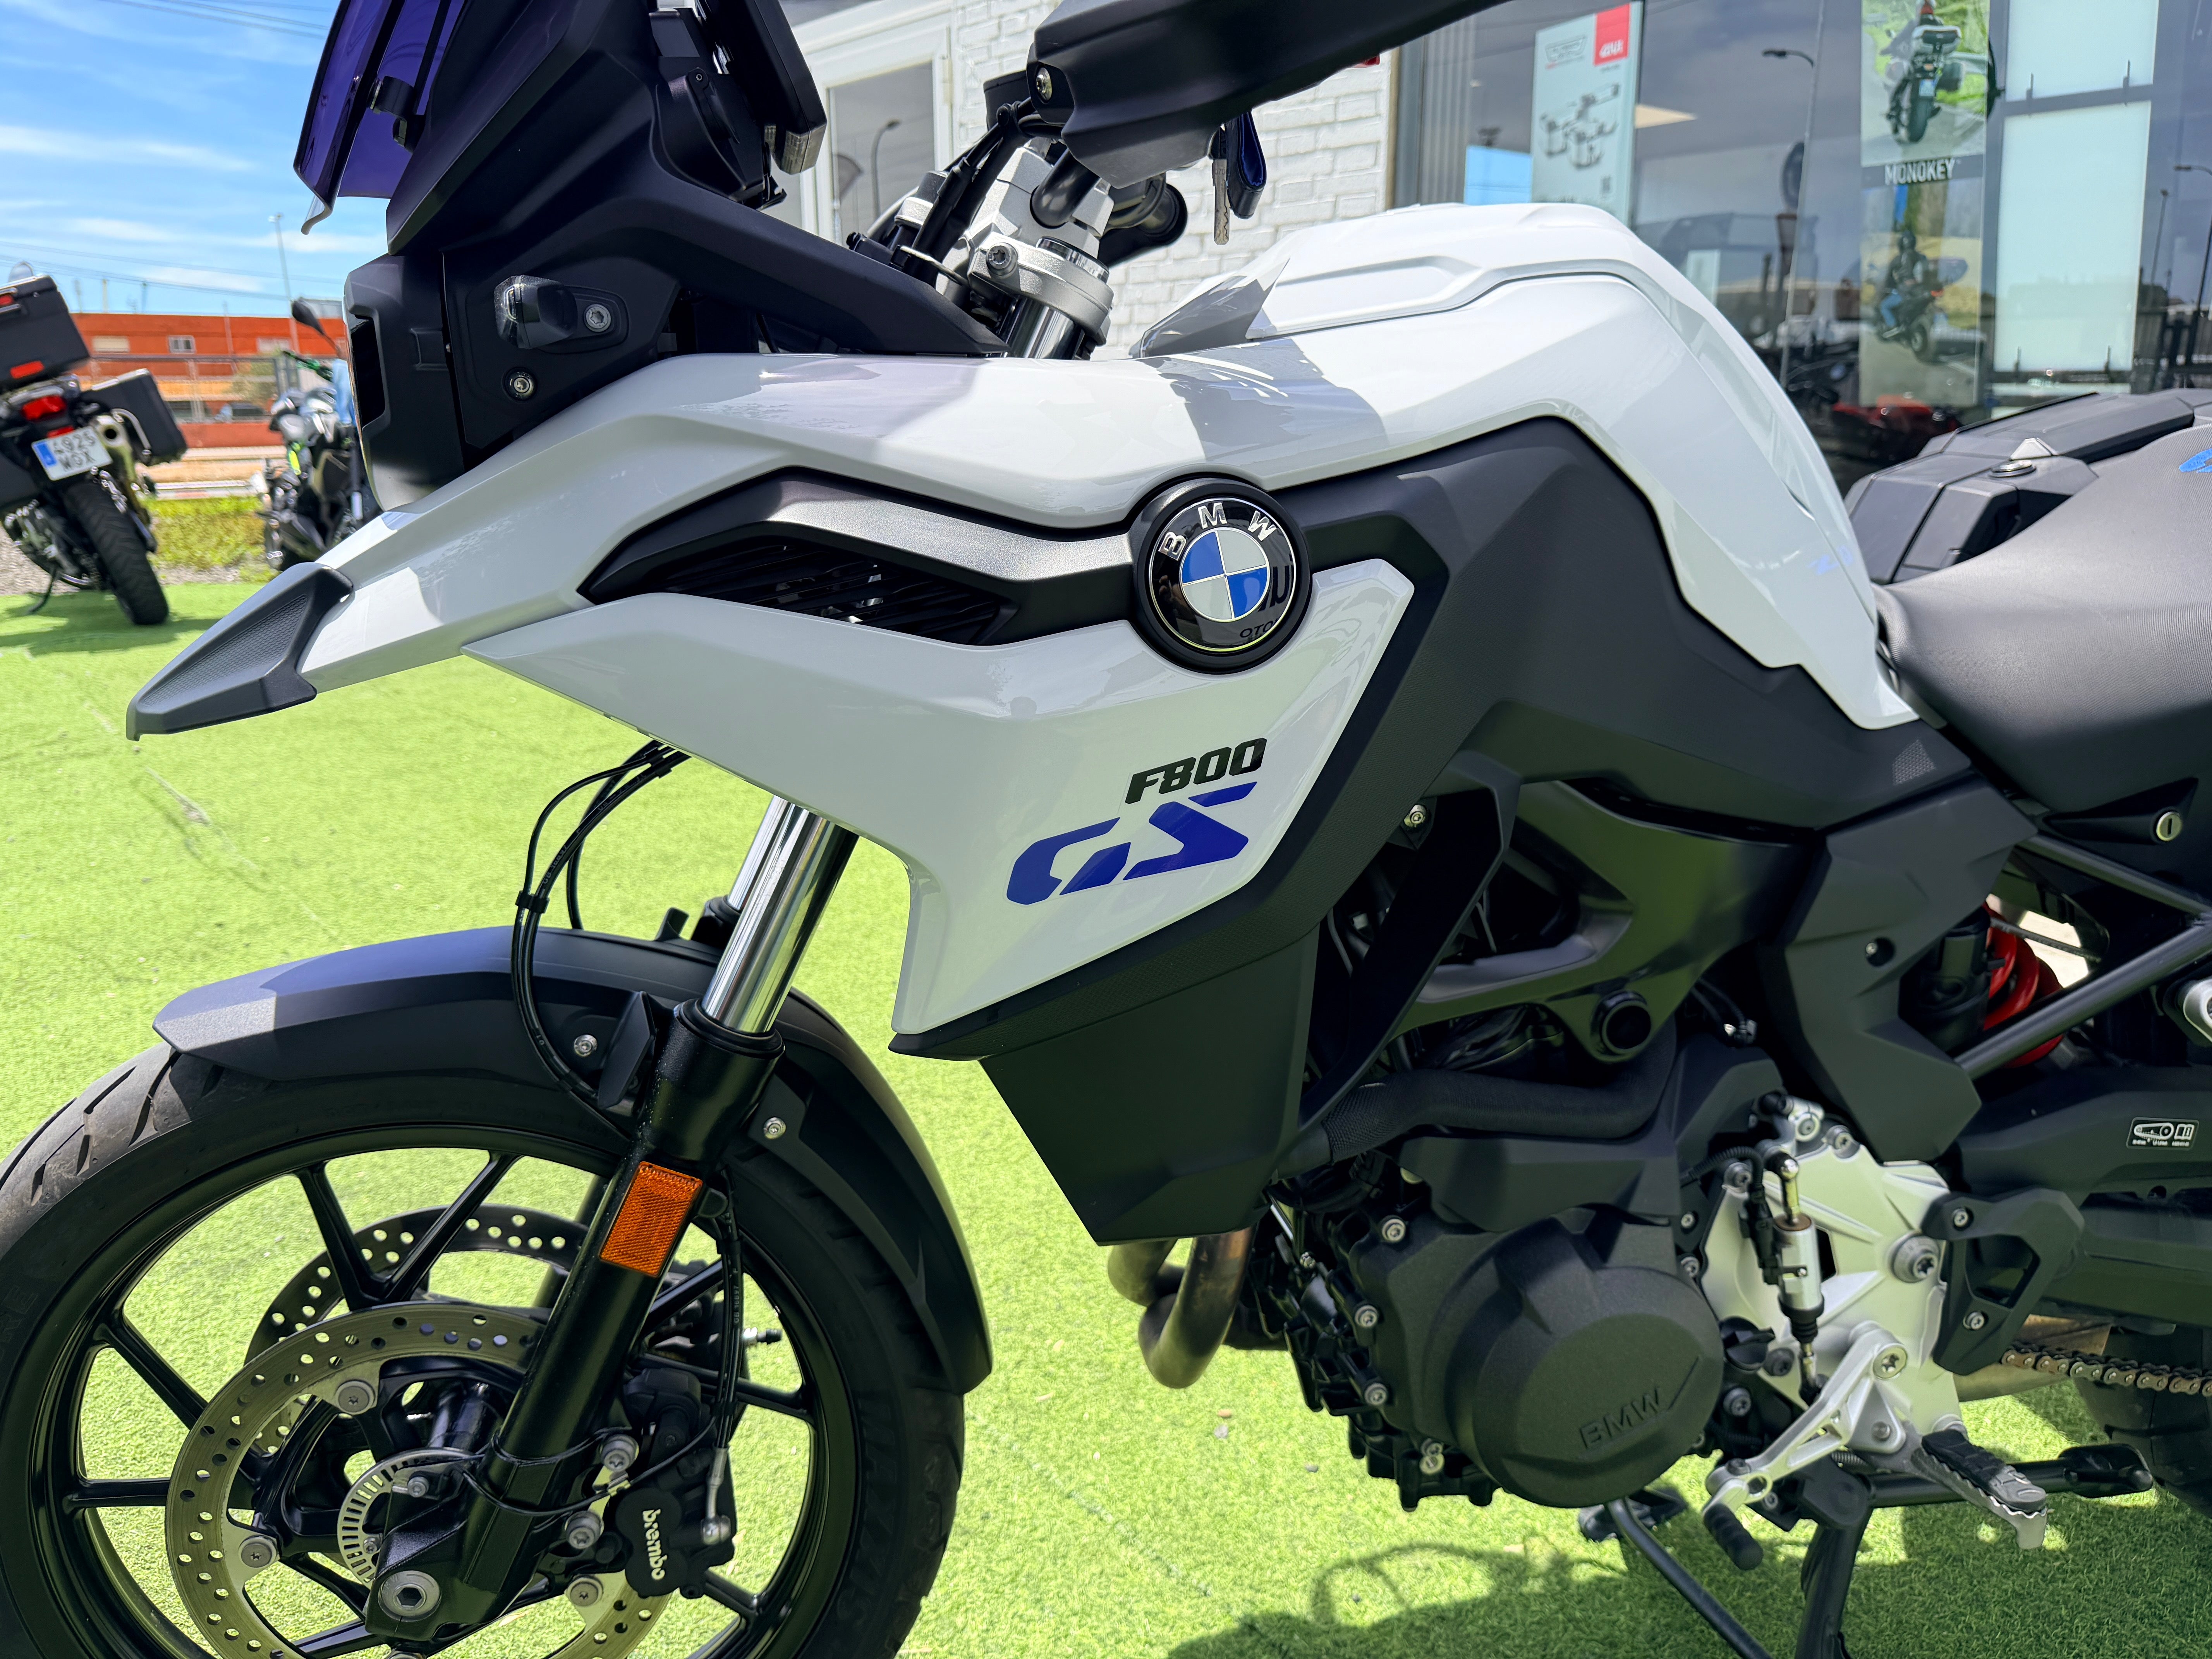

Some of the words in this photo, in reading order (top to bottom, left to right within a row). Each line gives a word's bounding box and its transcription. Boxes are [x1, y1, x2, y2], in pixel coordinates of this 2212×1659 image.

[1884, 158, 1955, 185] MONOKEY
[1158, 502, 1277, 561] BMW
[1125, 738, 1267, 804] F800
[1006, 781, 1257, 905] GS
[1580, 1385, 1661, 1449] BMW
[642, 1508, 668, 1581] brembo
